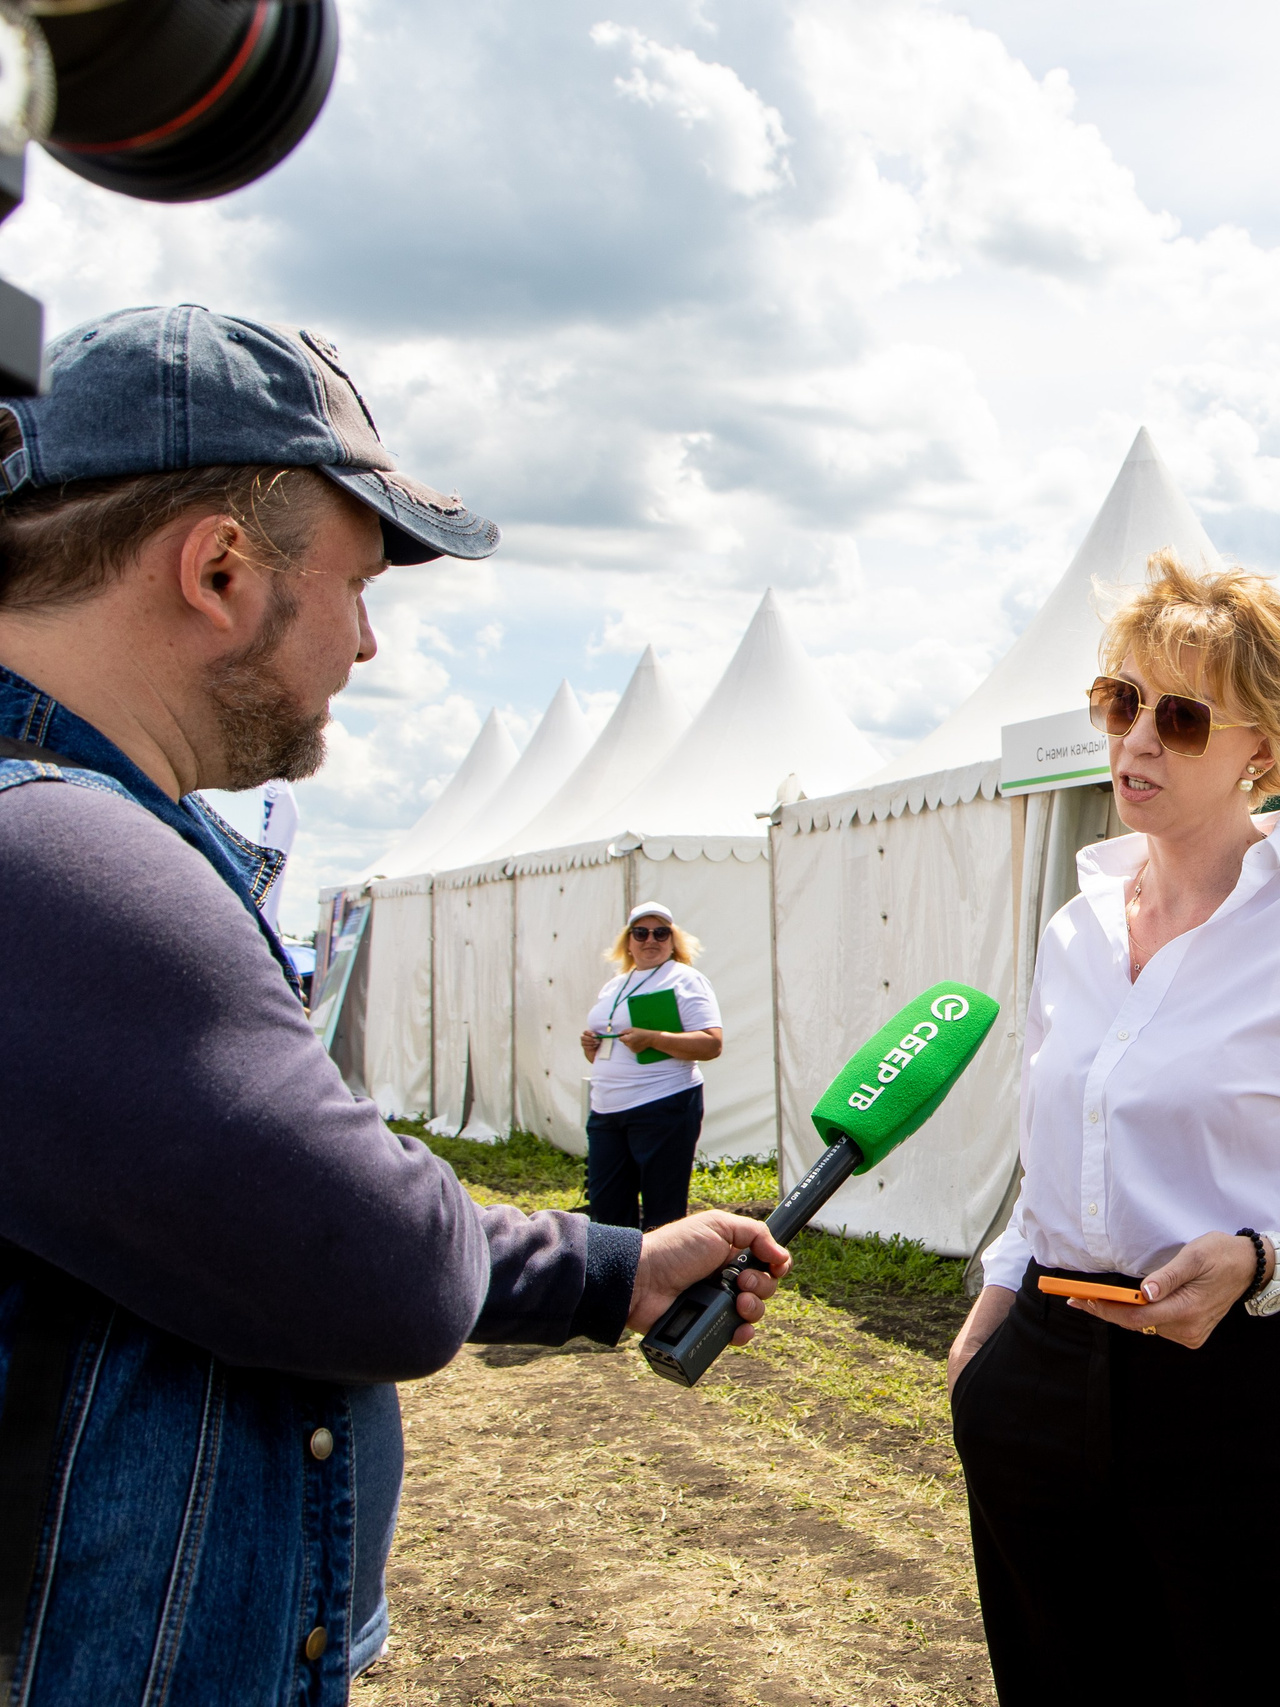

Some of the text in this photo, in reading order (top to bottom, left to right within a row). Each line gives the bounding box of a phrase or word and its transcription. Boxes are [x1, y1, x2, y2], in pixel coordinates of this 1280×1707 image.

[1036, 734, 1107, 762] С нами каждый
[877, 1021, 939, 1084] СБЕР
[848, 1083, 886, 1111] ТВ
[800, 1144, 841, 1189] SENNHEISER
[790, 1191, 801, 1201] MD
